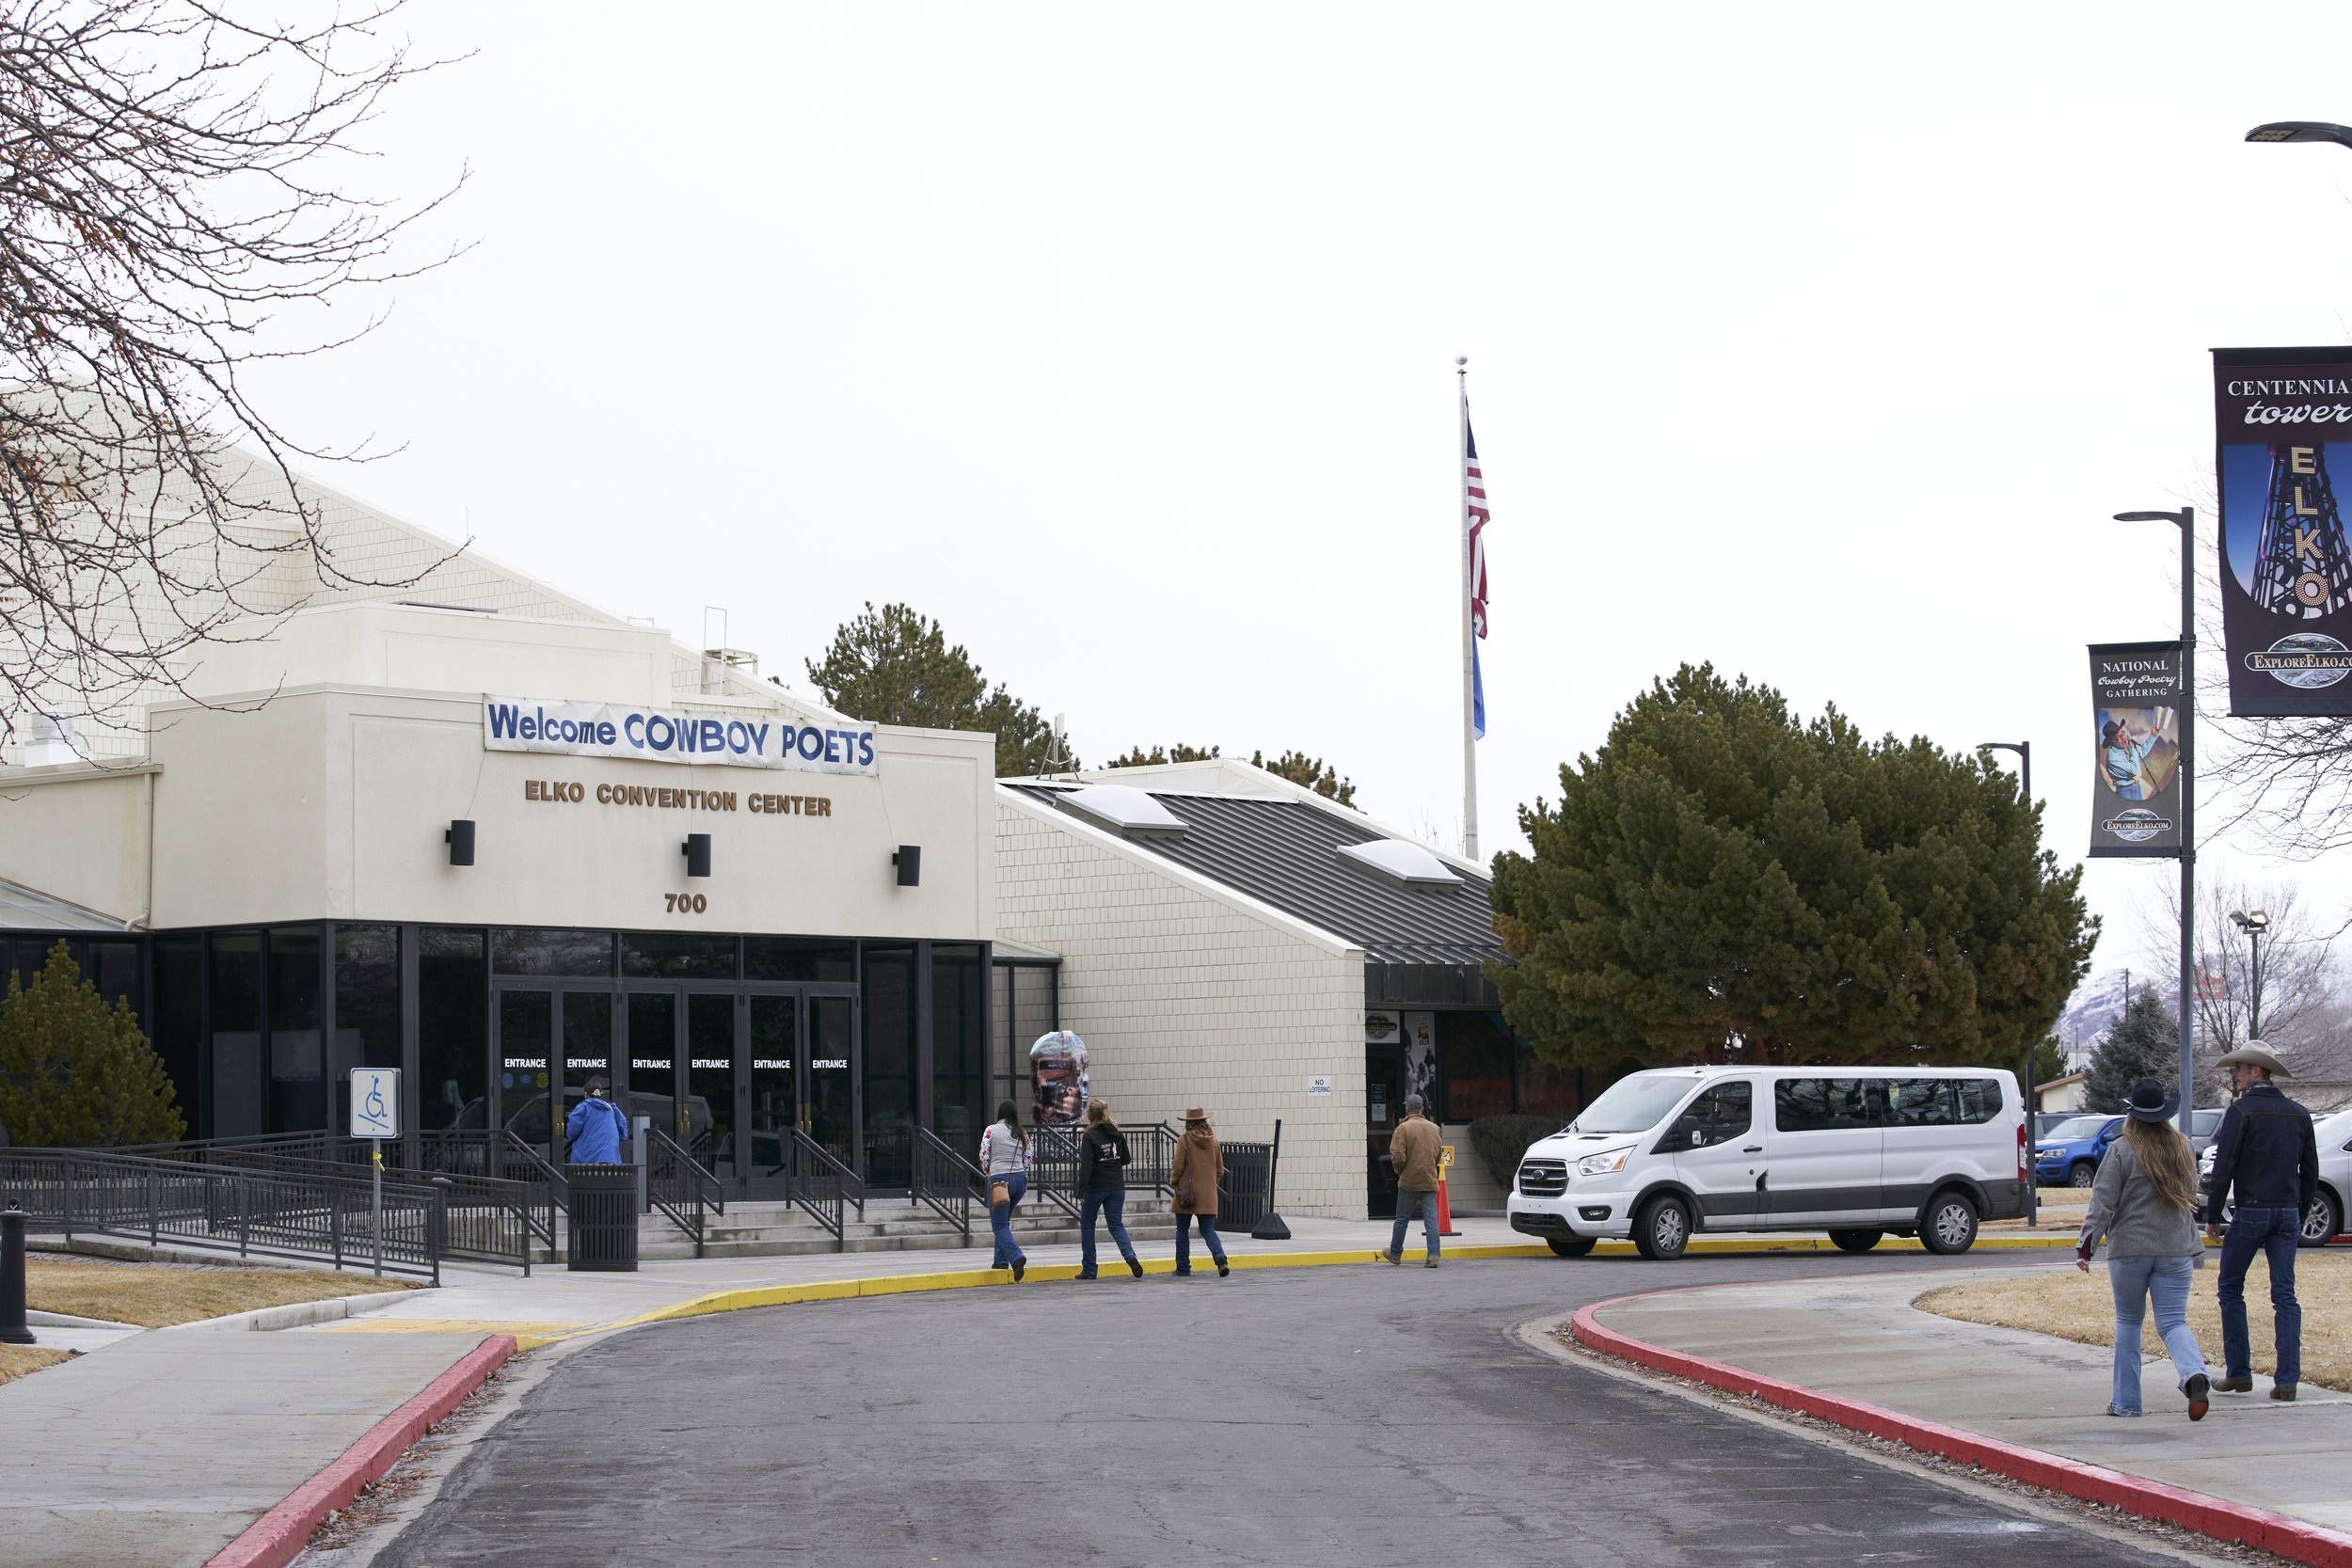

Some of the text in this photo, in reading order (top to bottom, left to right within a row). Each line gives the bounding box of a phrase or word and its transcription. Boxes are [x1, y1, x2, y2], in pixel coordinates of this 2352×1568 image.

[2228, 379, 2352, 396] CENTENNIA
[2244, 400, 2352, 425] tower
[2291, 446, 2330, 607] ELKO
[2103, 659, 2169, 673] NATIONAL
[2098, 674, 2177, 688] Cowboy Poetry
[2106, 688, 2168, 698] GATHERING
[488, 704, 875, 767] Welcome COWBOY POETS
[525, 780, 833, 817] ELKO CONVENTION CENTER
[664, 893, 707, 914] 700
[504, 1058, 547, 1069] ENTRANCE
[566, 1058, 607, 1069] ENTRANCE
[632, 1059, 672, 1069] ENTRANCE
[691, 1058, 730, 1069] ENTRANCE
[754, 1059, 791, 1069] ENTRANCE
[812, 1058, 848, 1069] ENTRANCE
